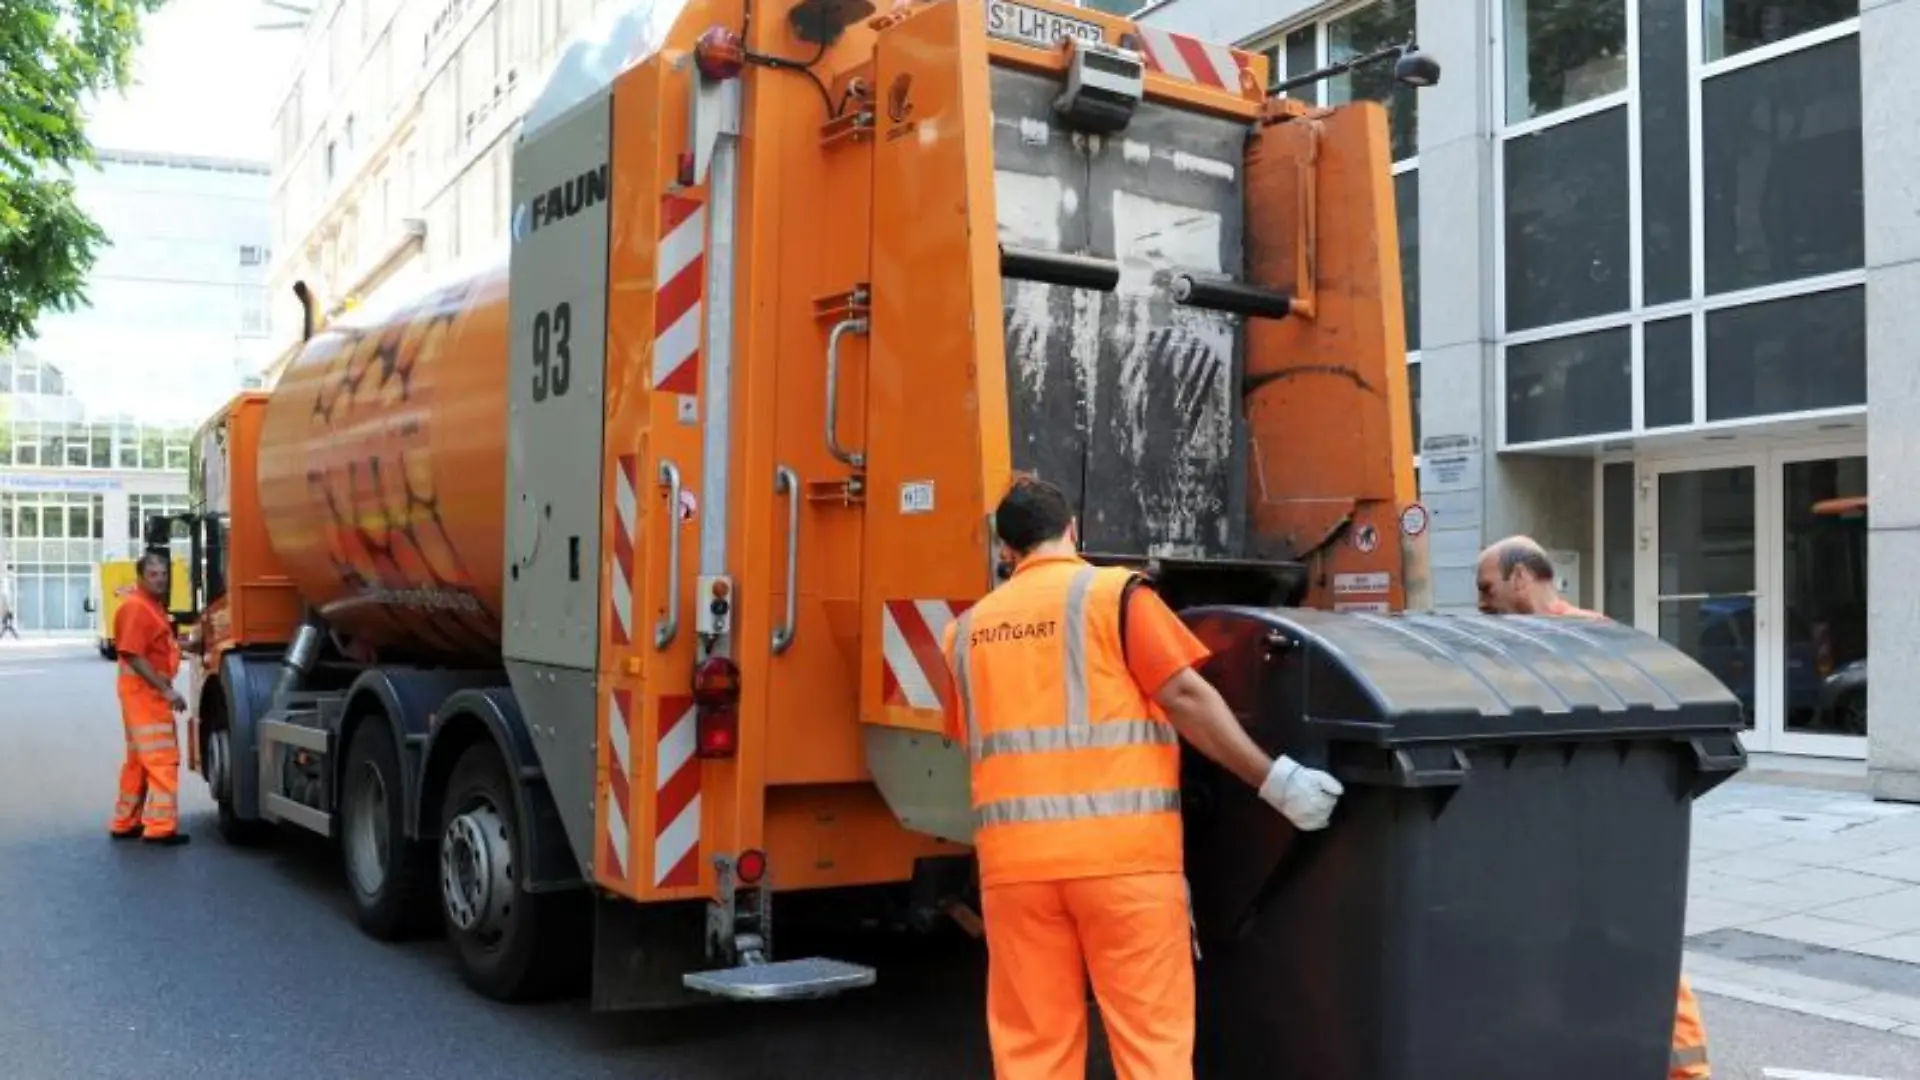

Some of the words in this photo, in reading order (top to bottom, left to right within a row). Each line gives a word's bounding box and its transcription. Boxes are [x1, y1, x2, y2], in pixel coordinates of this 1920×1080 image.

[990, 4, 1004, 29] S
[1019, 8, 1047, 39] LH
[531, 163, 607, 233] FAUN
[532, 302, 570, 403] 93
[970, 620, 1056, 648] STUTTGART
